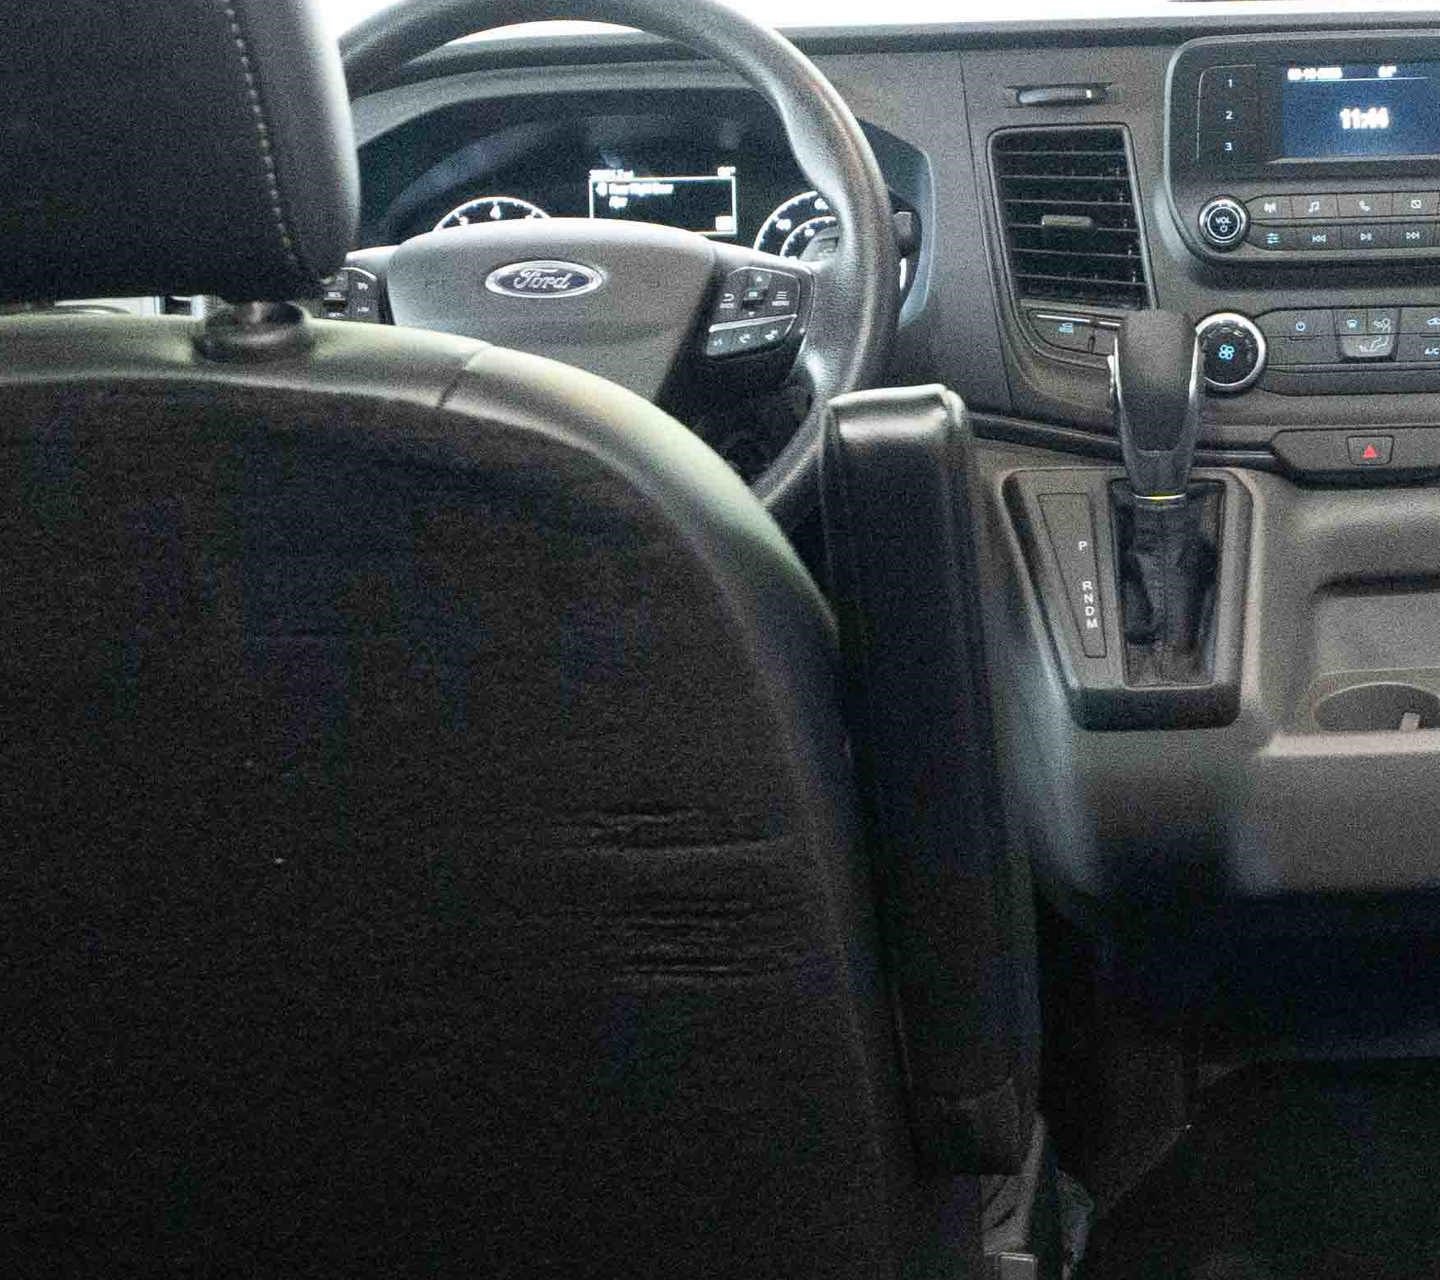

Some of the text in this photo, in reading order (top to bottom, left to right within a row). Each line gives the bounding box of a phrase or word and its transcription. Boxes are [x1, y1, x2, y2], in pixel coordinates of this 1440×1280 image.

[1227, 78, 1234, 89] 1
[1225, 110, 1234, 121] 2
[1224, 141, 1233, 152] 3
[1215, 216, 1232, 226] VOL
[513, 268, 573, 289] Ford
[1077, 540, 1088, 552] P
[1082, 580, 1093, 591] R
[1084, 593, 1094, 604] N
[1084, 606, 1095, 617] D
[1085, 618, 1099, 630] M
